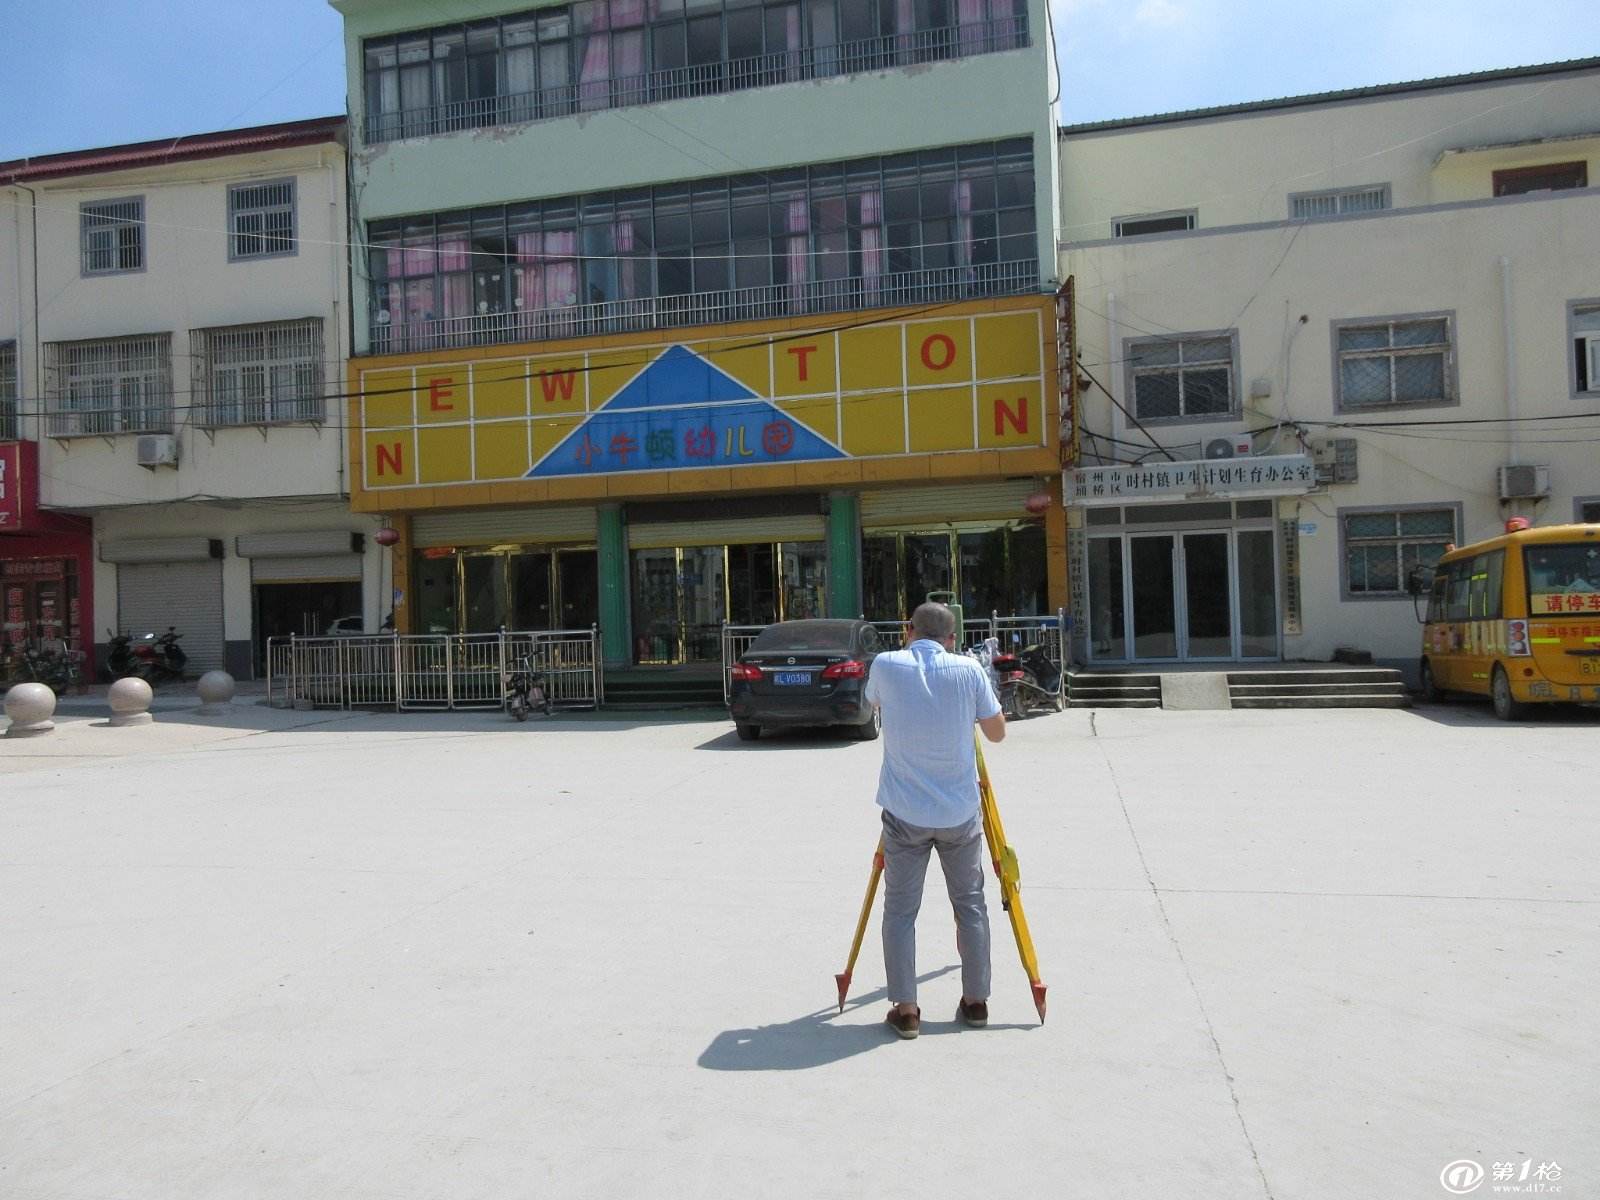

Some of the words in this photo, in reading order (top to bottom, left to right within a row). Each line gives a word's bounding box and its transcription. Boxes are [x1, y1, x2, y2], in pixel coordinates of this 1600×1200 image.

[575, 419, 795, 467] 小牛顿幼儿园
[1544, 594, 1600, 611] 请停车
